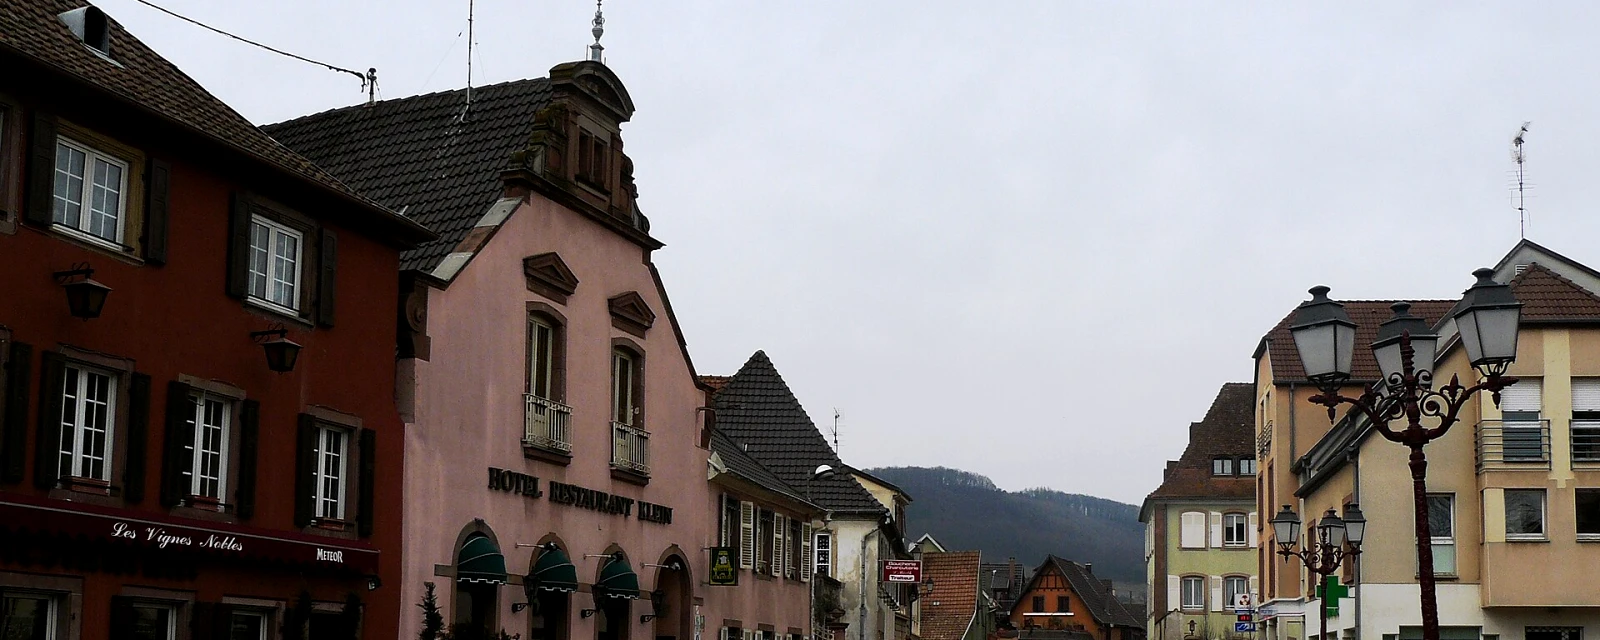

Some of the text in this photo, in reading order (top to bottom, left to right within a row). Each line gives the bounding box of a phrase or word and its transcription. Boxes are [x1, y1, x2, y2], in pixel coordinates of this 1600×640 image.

[488, 467, 673, 525] HOTEL RESTAURANT KLEIN
[111, 522, 243, 551] Les Vignes Nobles
[316, 548, 343, 563] METEOR
